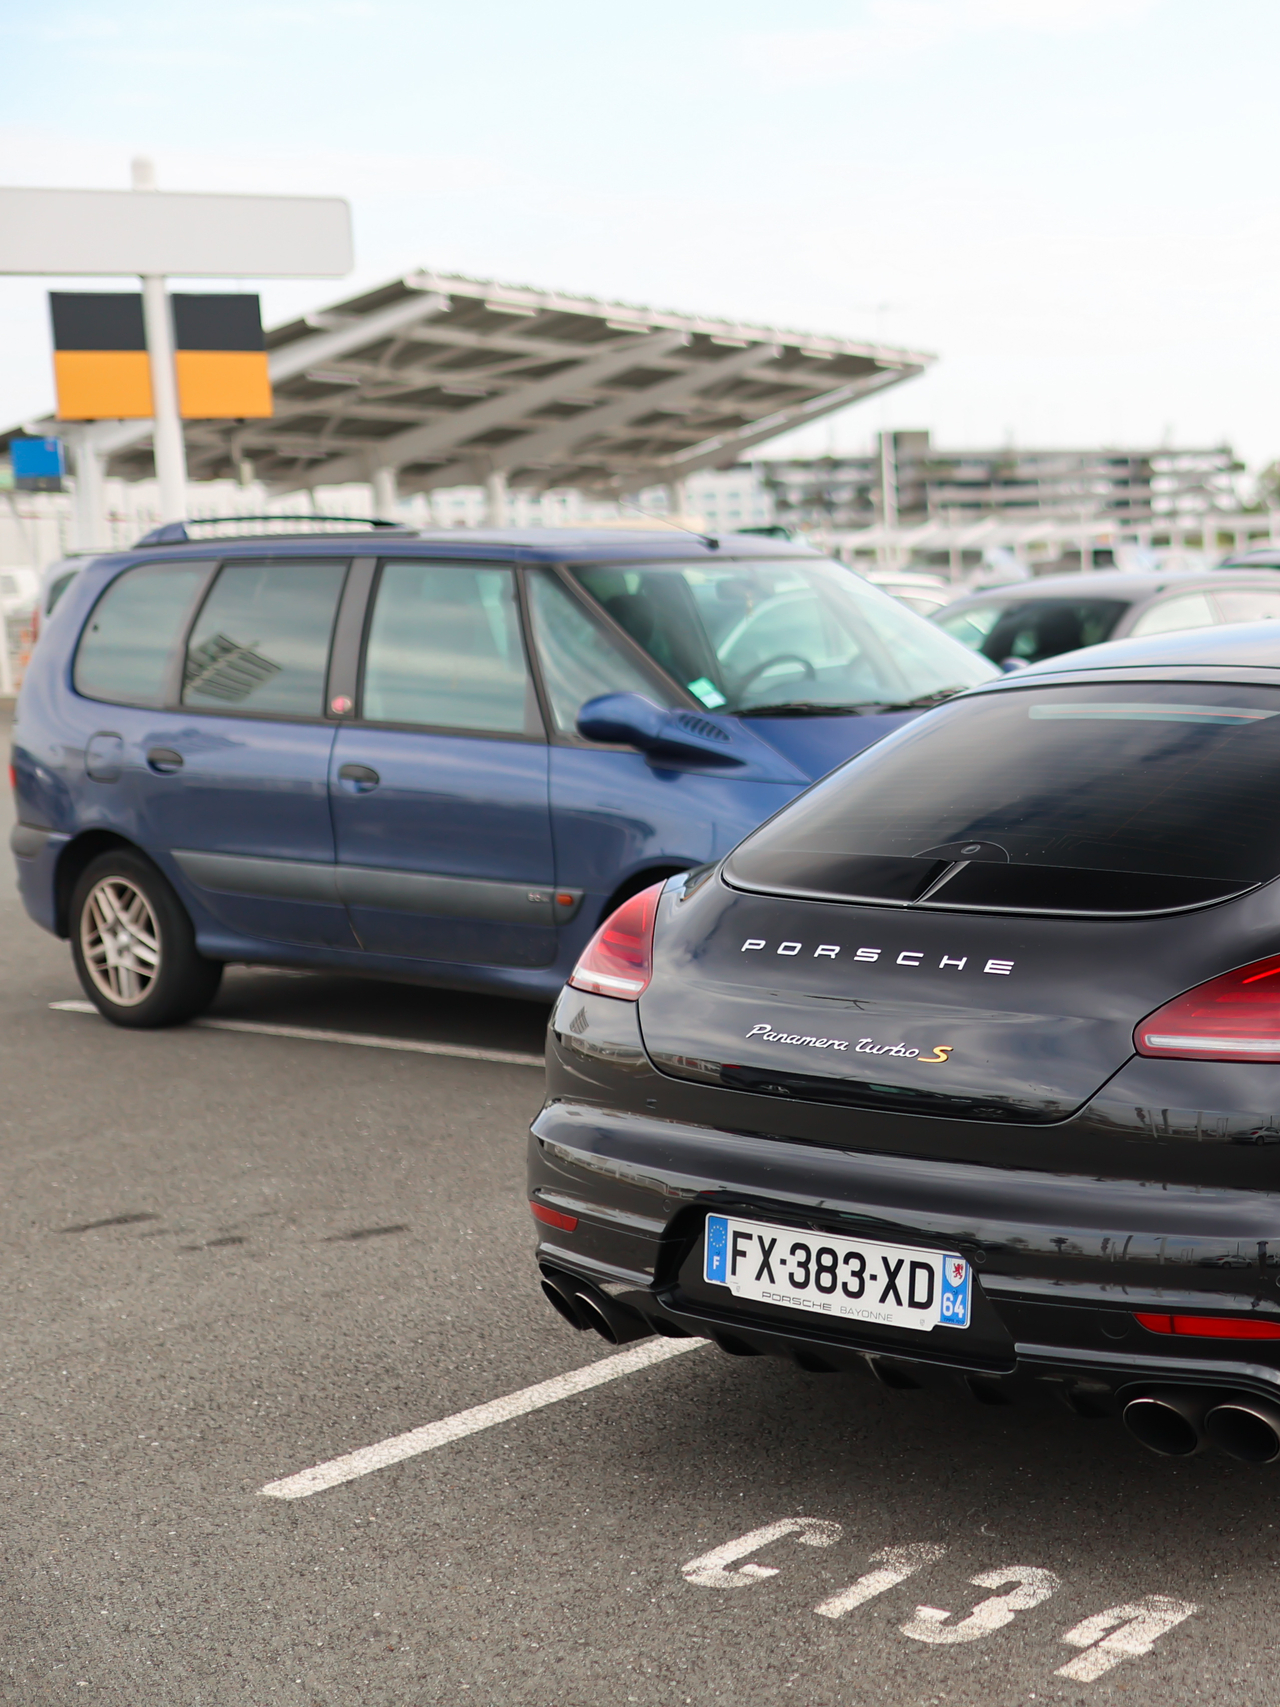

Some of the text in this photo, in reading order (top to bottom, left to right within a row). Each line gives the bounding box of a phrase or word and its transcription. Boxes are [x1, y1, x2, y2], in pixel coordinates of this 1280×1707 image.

[741, 939, 1015, 975] PORSCHE
[746, 1024, 953, 1063] Panamera turbo S
[712, 1256, 720, 1270] F
[730, 1230, 935, 1310] FX-383-XD
[762, 1291, 893, 1322] PORSCHE BAYONNE
[943, 1292, 965, 1318] 64
